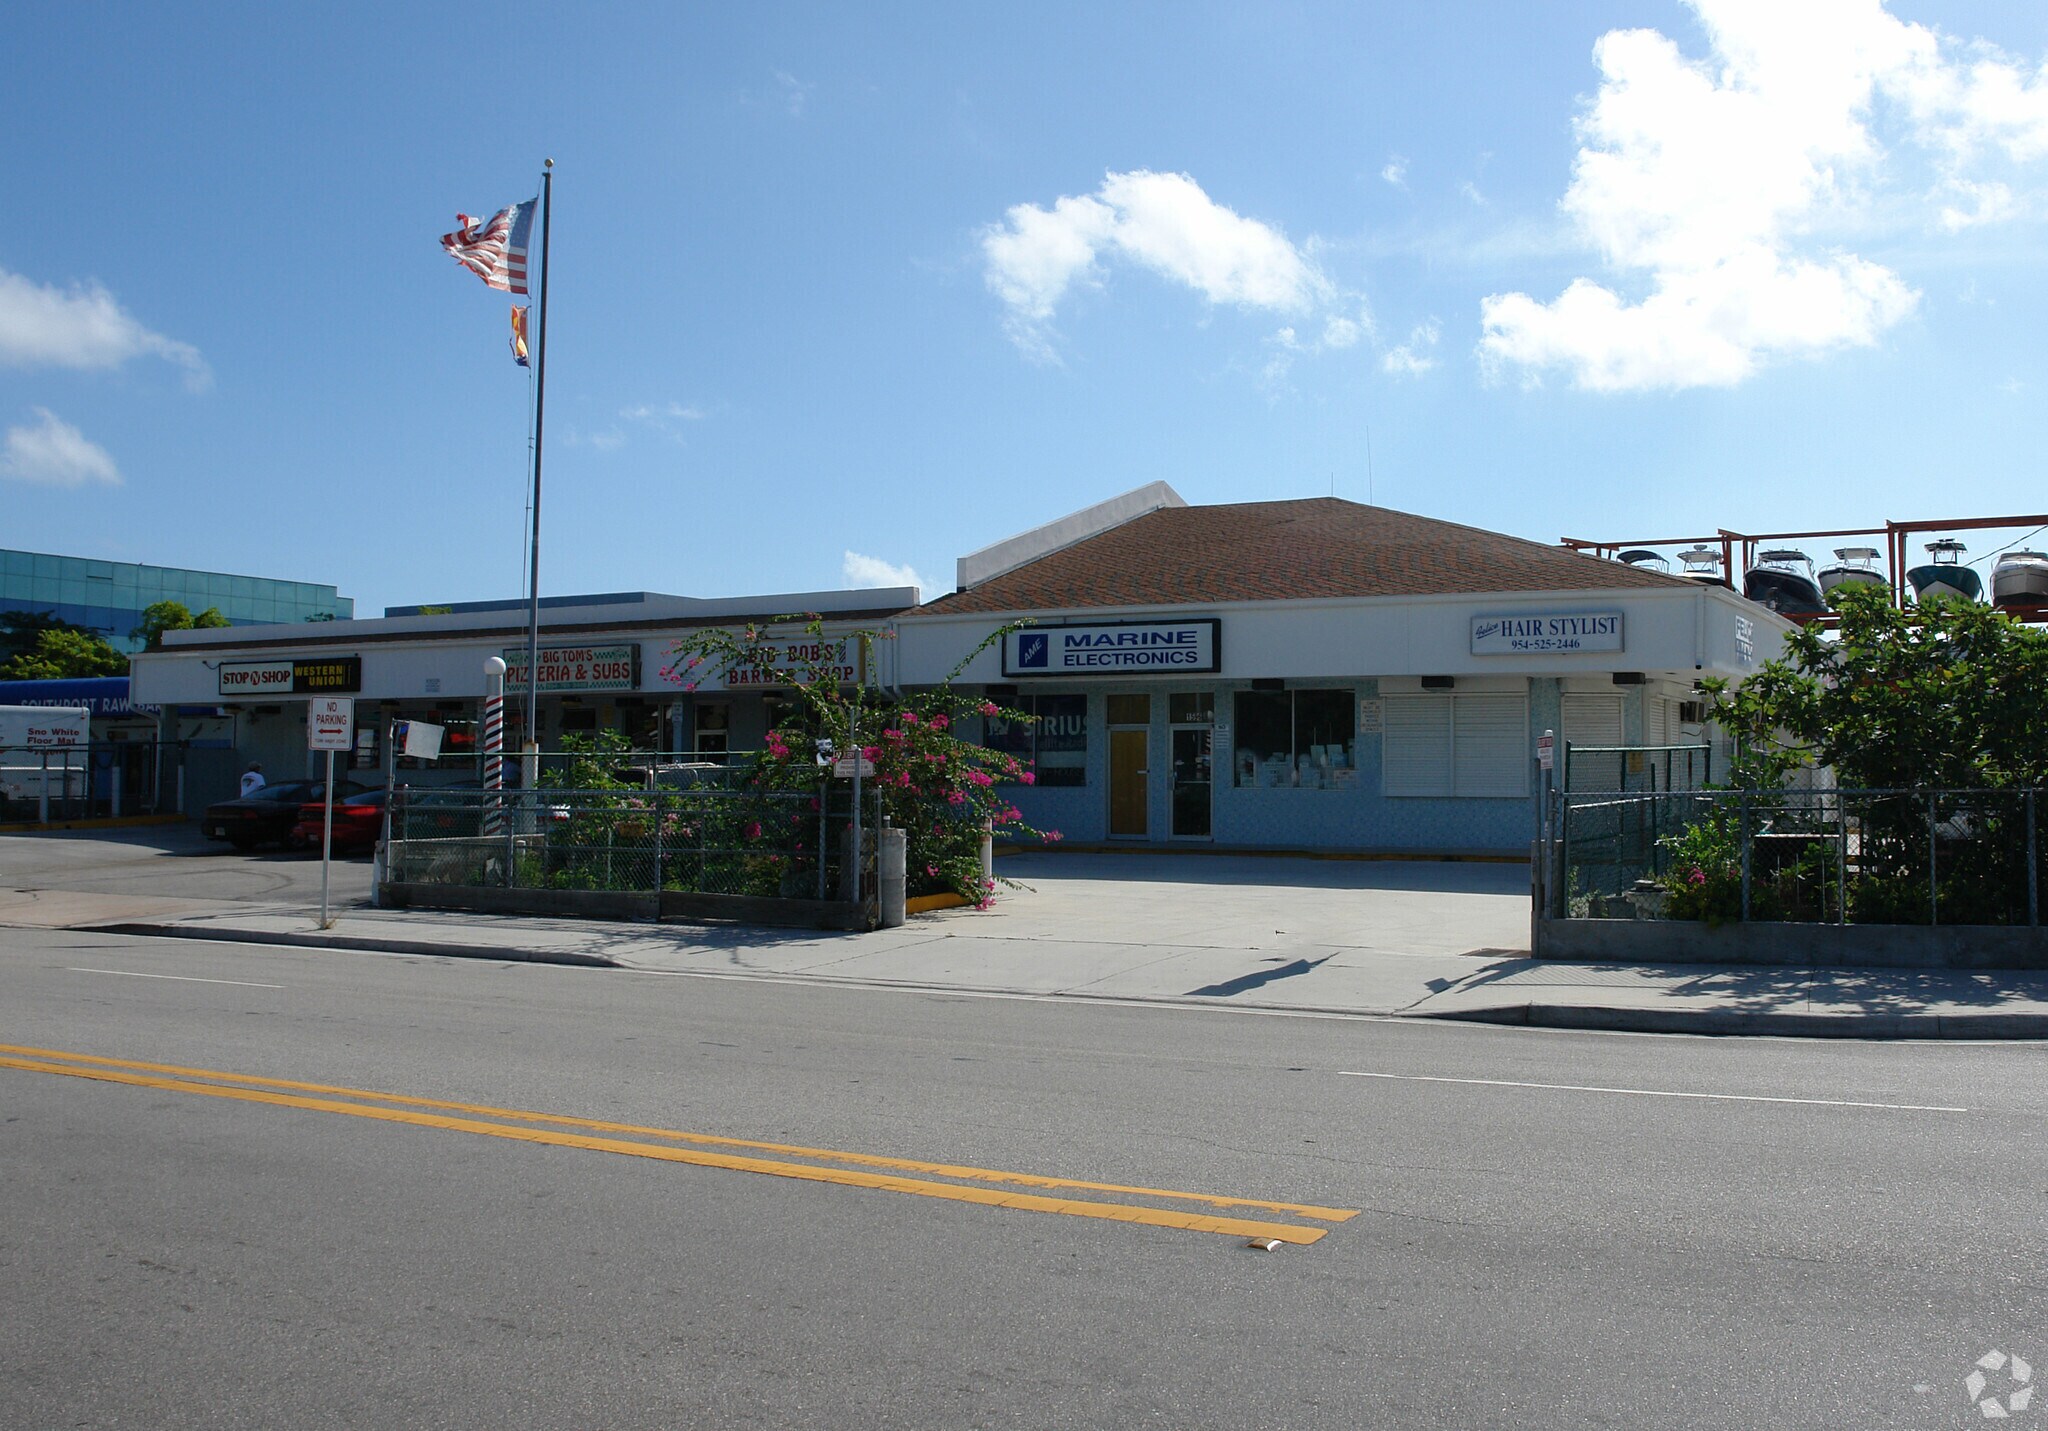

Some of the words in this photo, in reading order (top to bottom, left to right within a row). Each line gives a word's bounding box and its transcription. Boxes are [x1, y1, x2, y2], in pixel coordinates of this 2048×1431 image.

[1502, 619, 1543, 637] HAIR
[1549, 617, 1618, 636] STYLIST
[1064, 631, 1197, 647] MARINE
[1511, 638, 1580, 650] 954-525-2446
[543, 650, 560, 664] BIG
[562, 649, 593, 663] TOM'S
[748, 646, 777, 663] BIG
[787, 644, 834, 663] BOBS
[1023, 637, 1043, 664] AME
[1064, 651, 1198, 667] ELECTRONICS
[223, 672, 249, 685] STOP
[251, 671, 261, 685] N
[261, 670, 290, 684] SHOP
[294, 664, 343, 677] WESTERN
[506, 665, 570, 684] PIZERIA
[575, 664, 588, 681] &
[592, 662, 630, 680] SUBS
[308, 675, 343, 687] UNION
[102, 697, 130, 712] RAW
[327, 701, 338, 712] NO
[316, 714, 347, 726] PARKING
[27, 727, 47, 736] Sno
[51, 728, 80, 736] White
[27, 736, 54, 745] Floor
[57, 737, 76, 745] Mat
